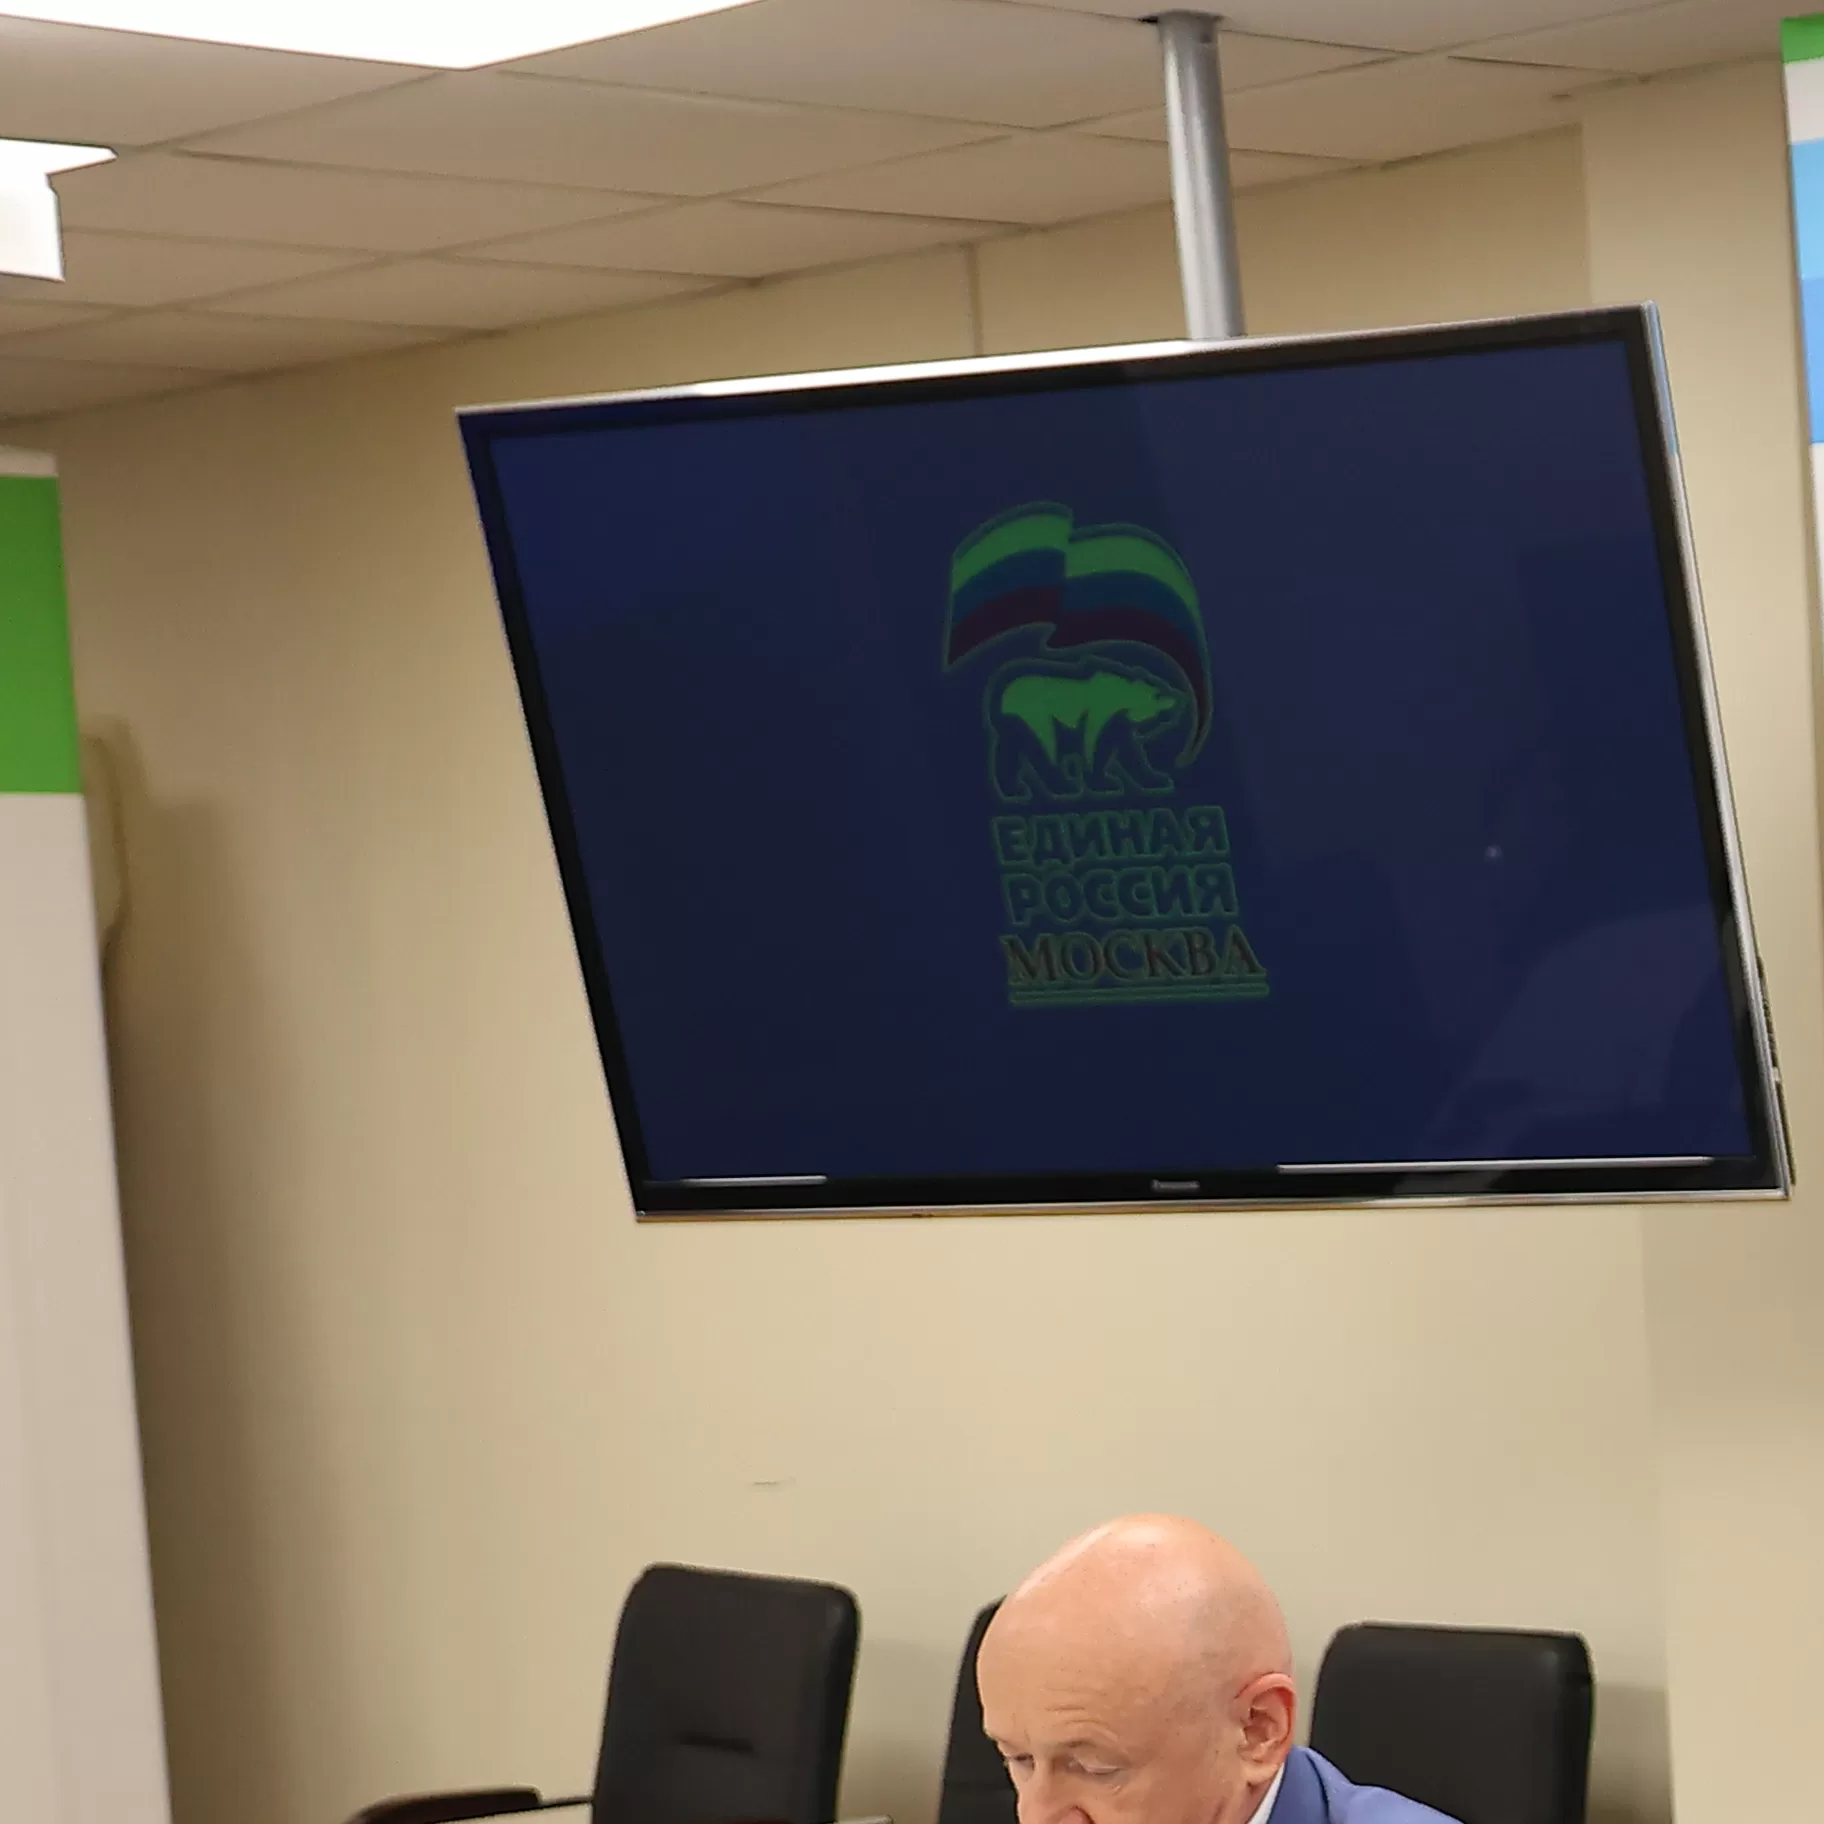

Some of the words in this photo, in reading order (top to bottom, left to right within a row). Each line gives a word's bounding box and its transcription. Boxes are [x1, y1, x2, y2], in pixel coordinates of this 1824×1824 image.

[993, 806, 1230, 868] ЕДИНАЯ
[1004, 863, 1239, 926] РОССИЯ
[1002, 926, 1267, 984] МОСКВА
